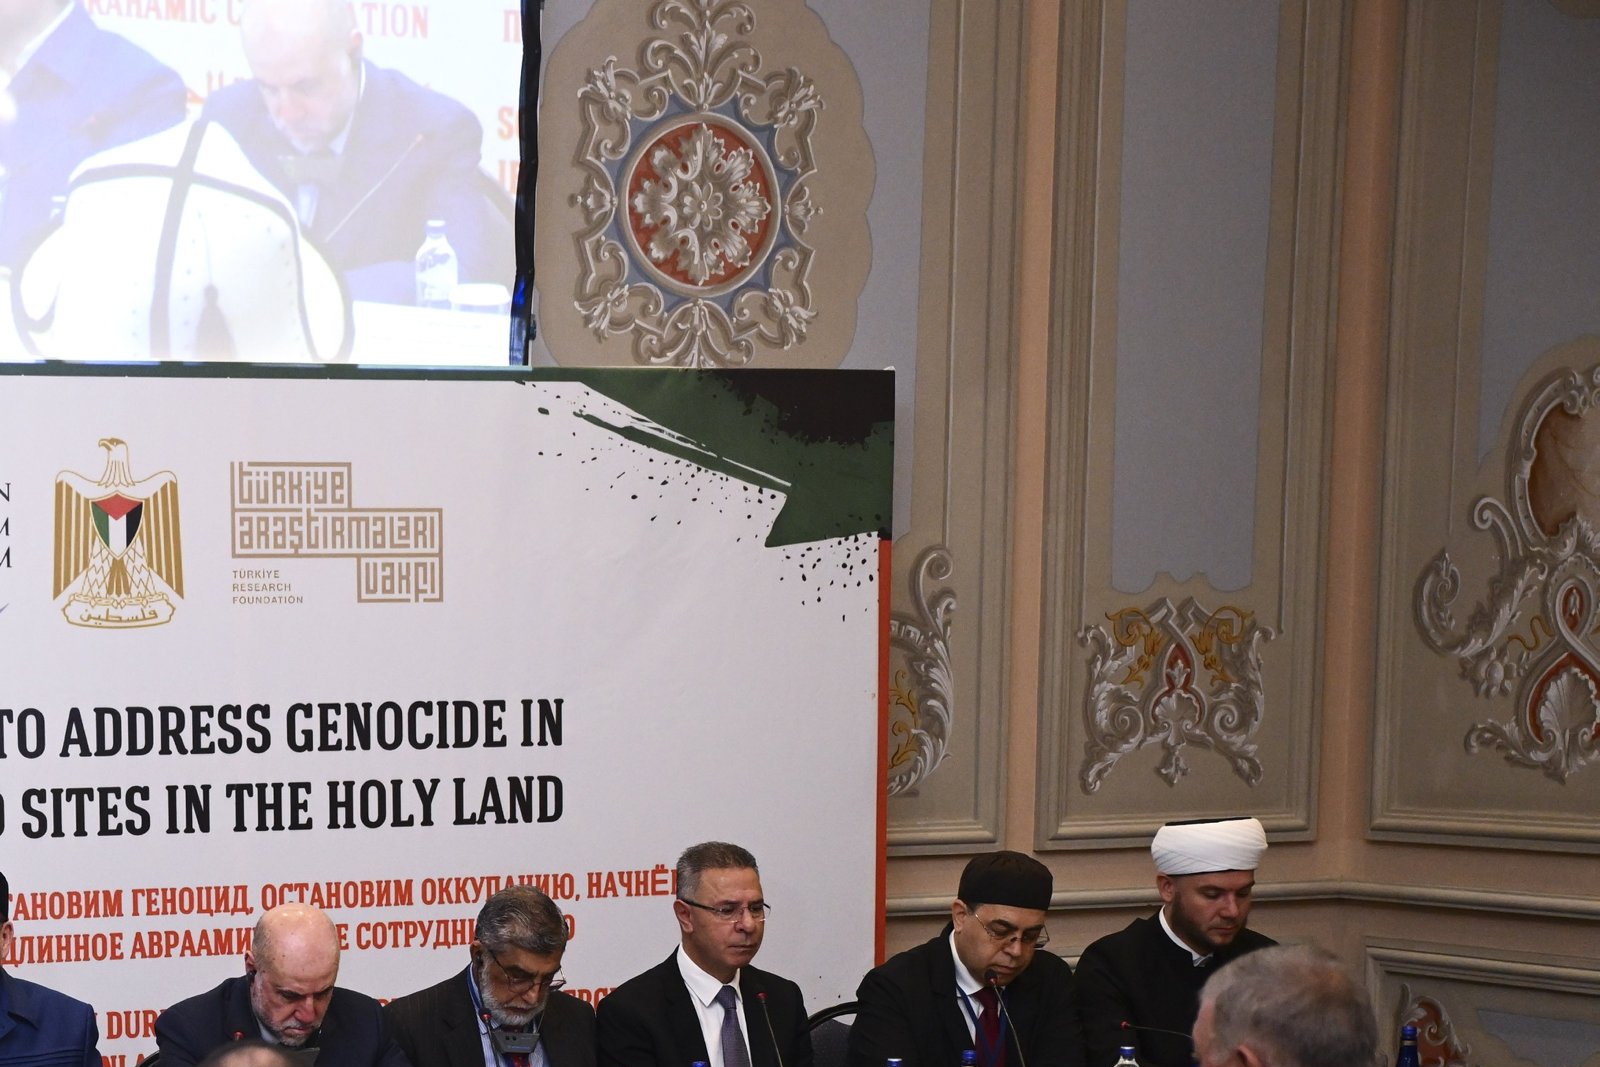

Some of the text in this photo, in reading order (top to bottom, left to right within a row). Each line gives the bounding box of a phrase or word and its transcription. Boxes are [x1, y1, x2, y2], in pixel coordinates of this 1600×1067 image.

[233, 569, 279, 579] TÜRKİYE
[233, 583, 291, 592] RESEARCH
[233, 595, 303, 604] FOUNDATION
[80, 605, 158, 625] فلسطين
[59, 704, 271, 757] ADDRESS
[287, 700, 507, 753] GENOCIDE
[521, 698, 564, 747] IN
[22, 786, 150, 839] SITES
[166, 784, 211, 834] IN
[226, 782, 313, 832] THE
[327, 778, 440, 829] HOLY
[453, 775, 563, 825] LAND
[132, 885, 254, 916] ГЕНОЦИД,
